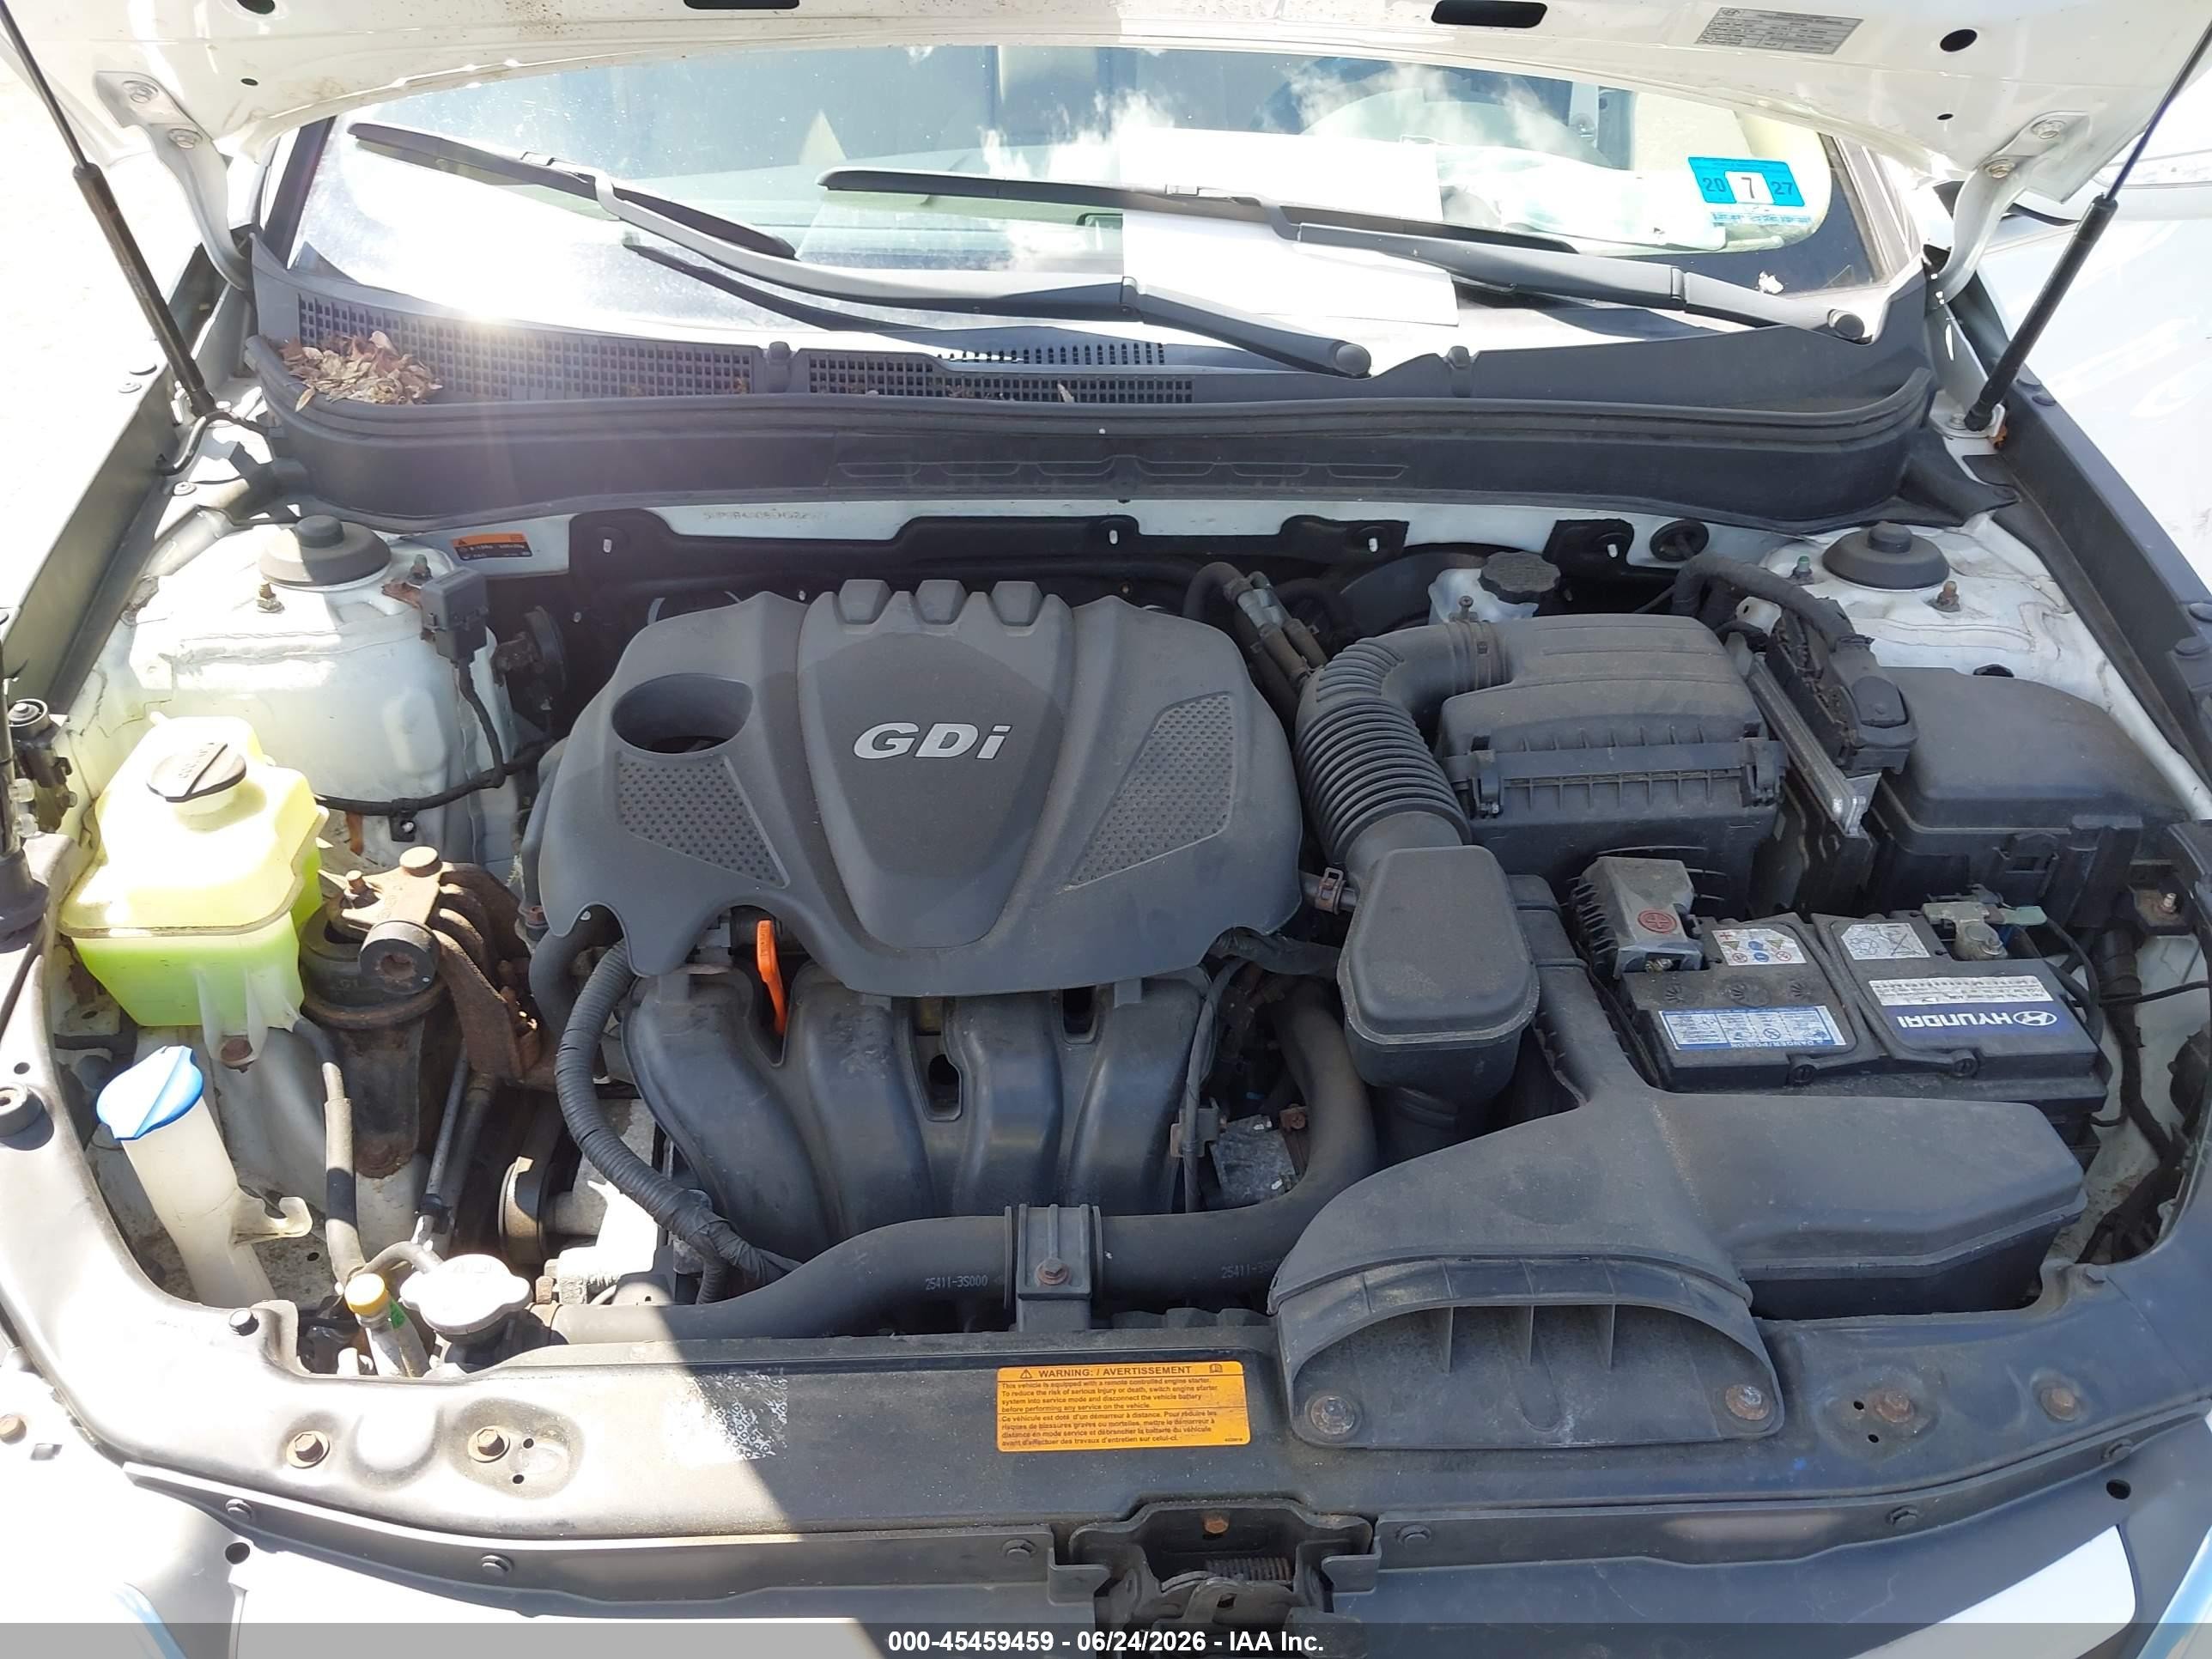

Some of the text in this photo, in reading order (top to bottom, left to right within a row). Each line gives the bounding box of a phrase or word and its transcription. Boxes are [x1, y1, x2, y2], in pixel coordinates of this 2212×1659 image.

[1703, 176, 1793, 199] 20 7 27
[854, 722, 1012, 759] GDi
[1896, 1012, 2014, 1028] HYUNDAI
[1038, 1368, 1093, 1378] WARNING:
[1103, 1365, 1192, 1376] AVERTISSEMENT
